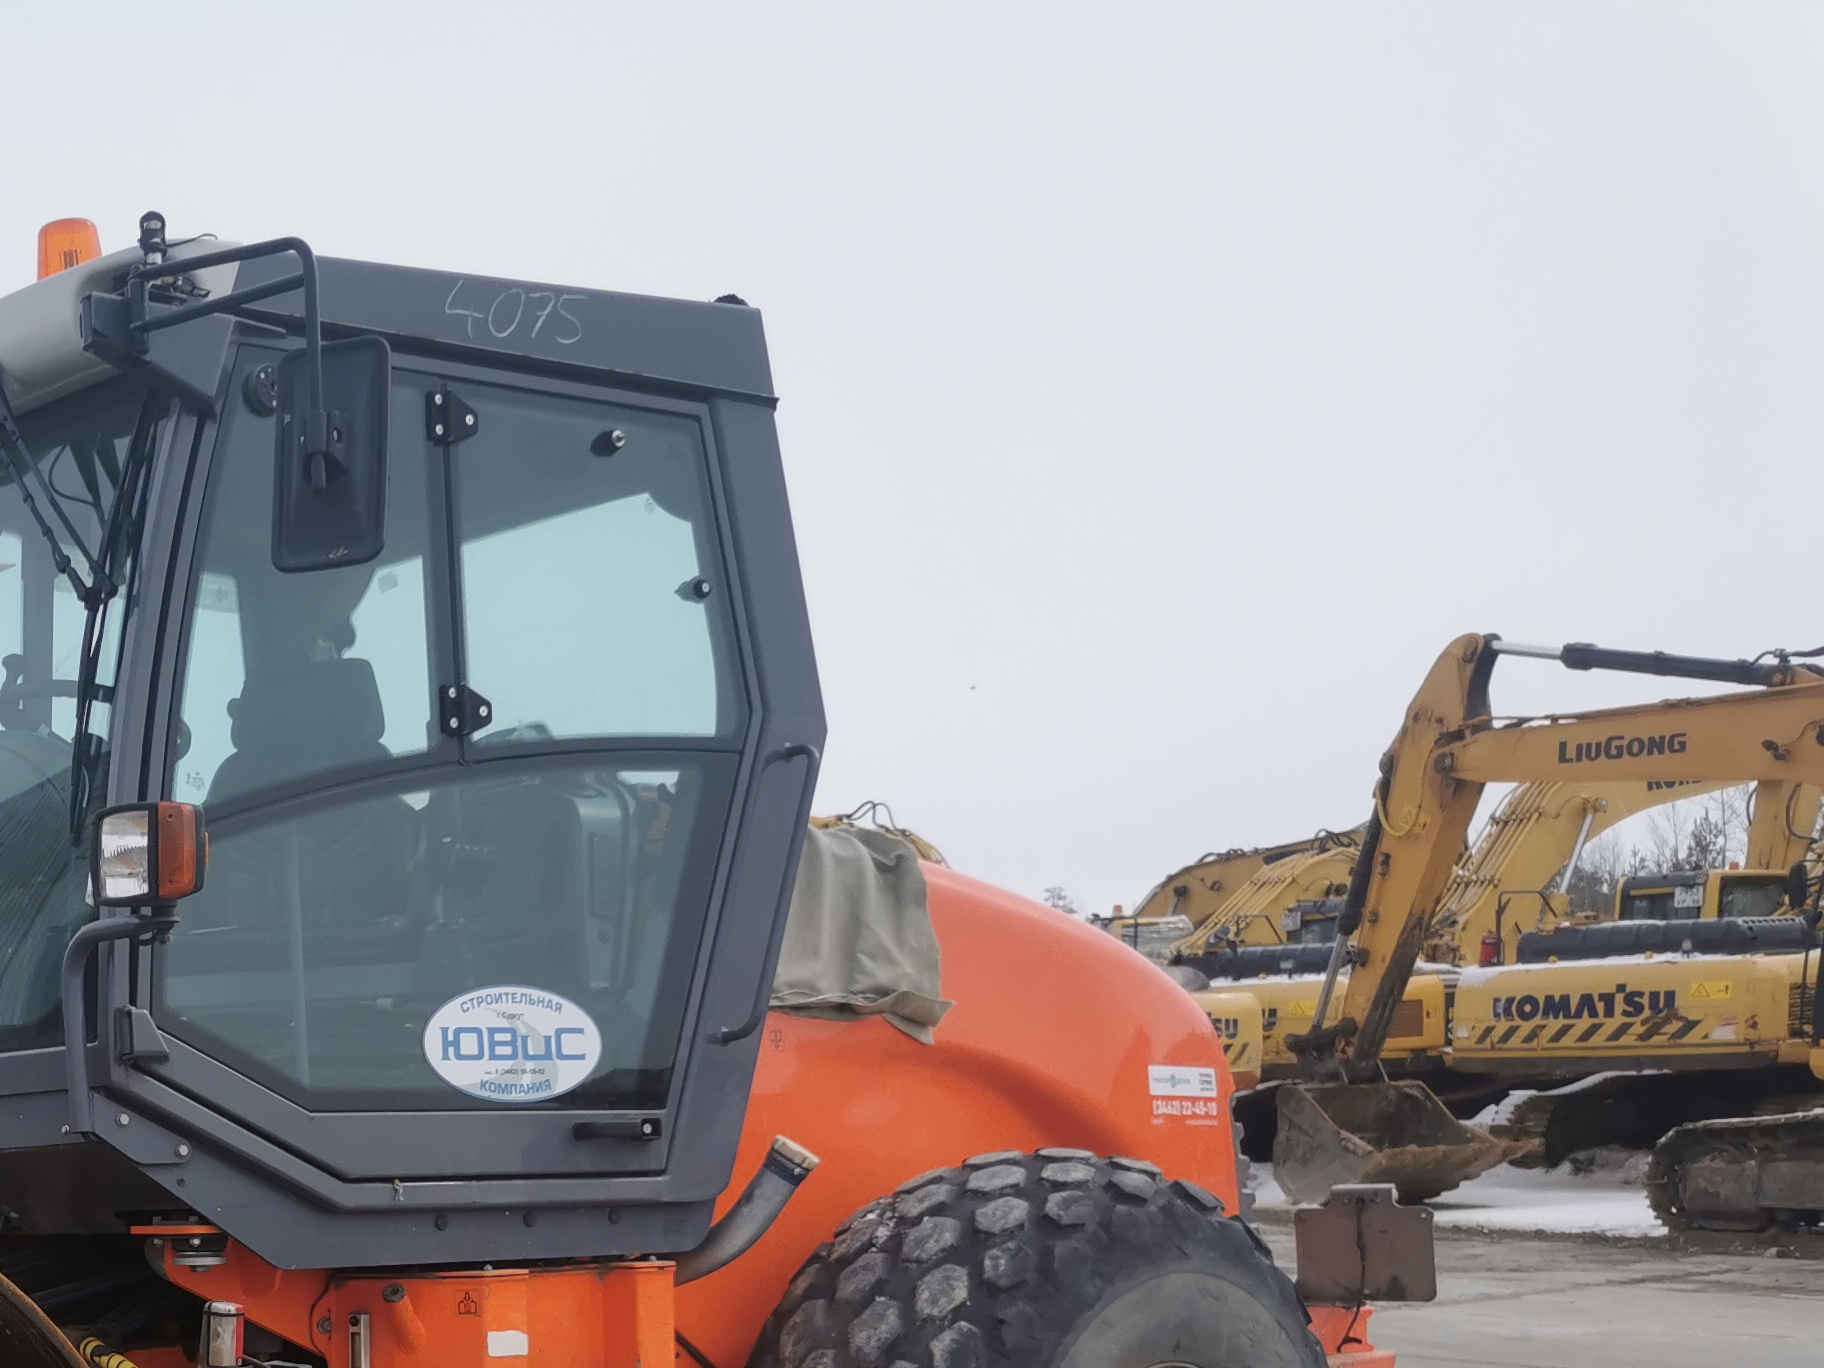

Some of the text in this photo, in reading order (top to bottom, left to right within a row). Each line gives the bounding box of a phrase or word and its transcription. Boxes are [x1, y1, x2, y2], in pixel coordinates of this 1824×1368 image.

[444, 280, 588, 344] 4075
[460, 991, 563, 1015] СТРОИТЕЛЬНАЯ
[1493, 983, 1676, 1022] KOMATSU
[479, 1078, 553, 1095] КОМПАНИЯ
